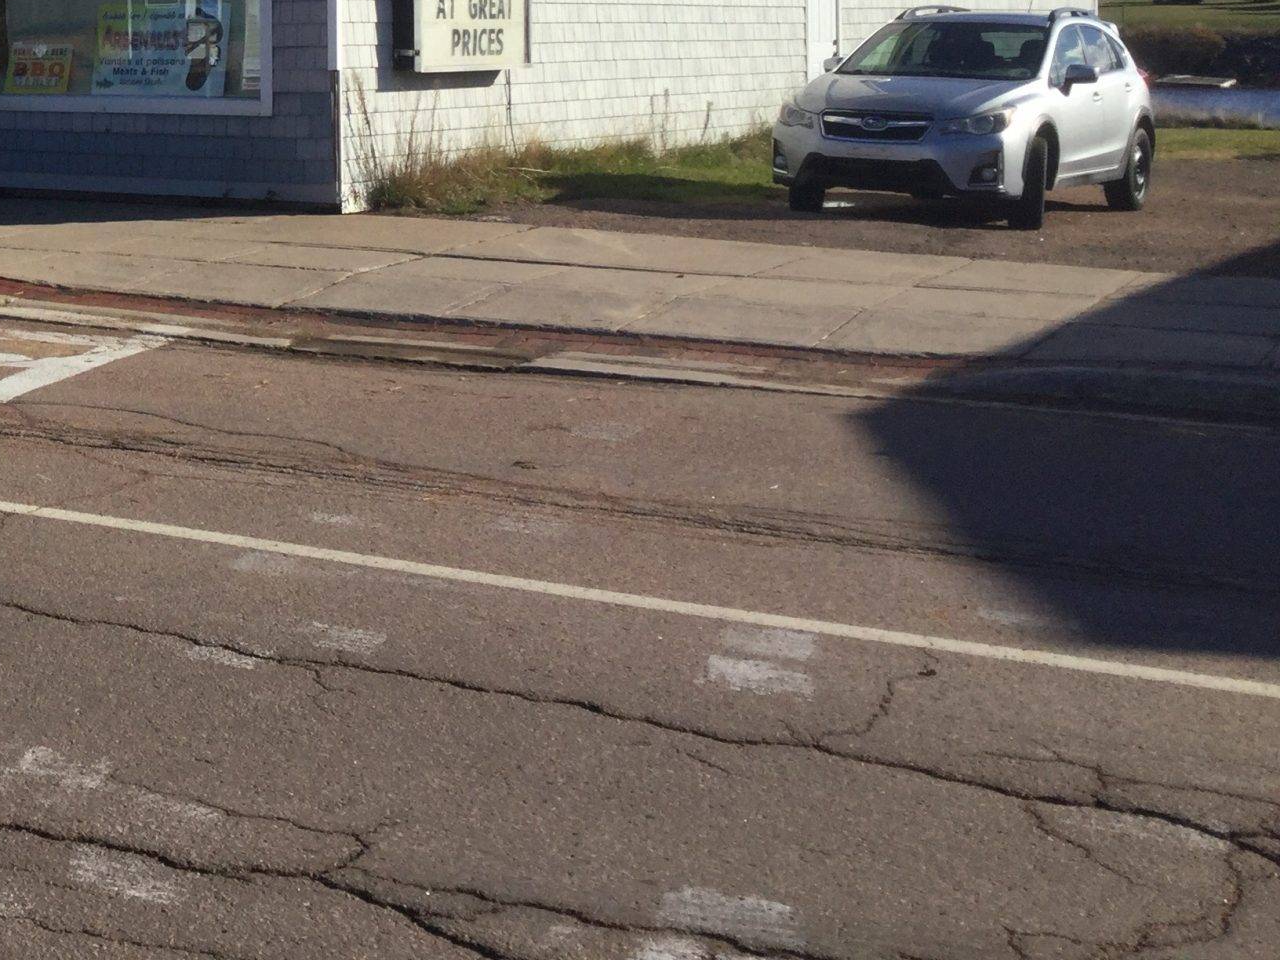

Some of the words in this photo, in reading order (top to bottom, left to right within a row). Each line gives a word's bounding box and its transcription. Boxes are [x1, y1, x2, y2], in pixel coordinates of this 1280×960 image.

[451, 28, 504, 57] PRICES
[13, 62, 66, 79] BBQ
[113, 67, 138, 76] Meats
[150, 67, 169, 76] Fish
